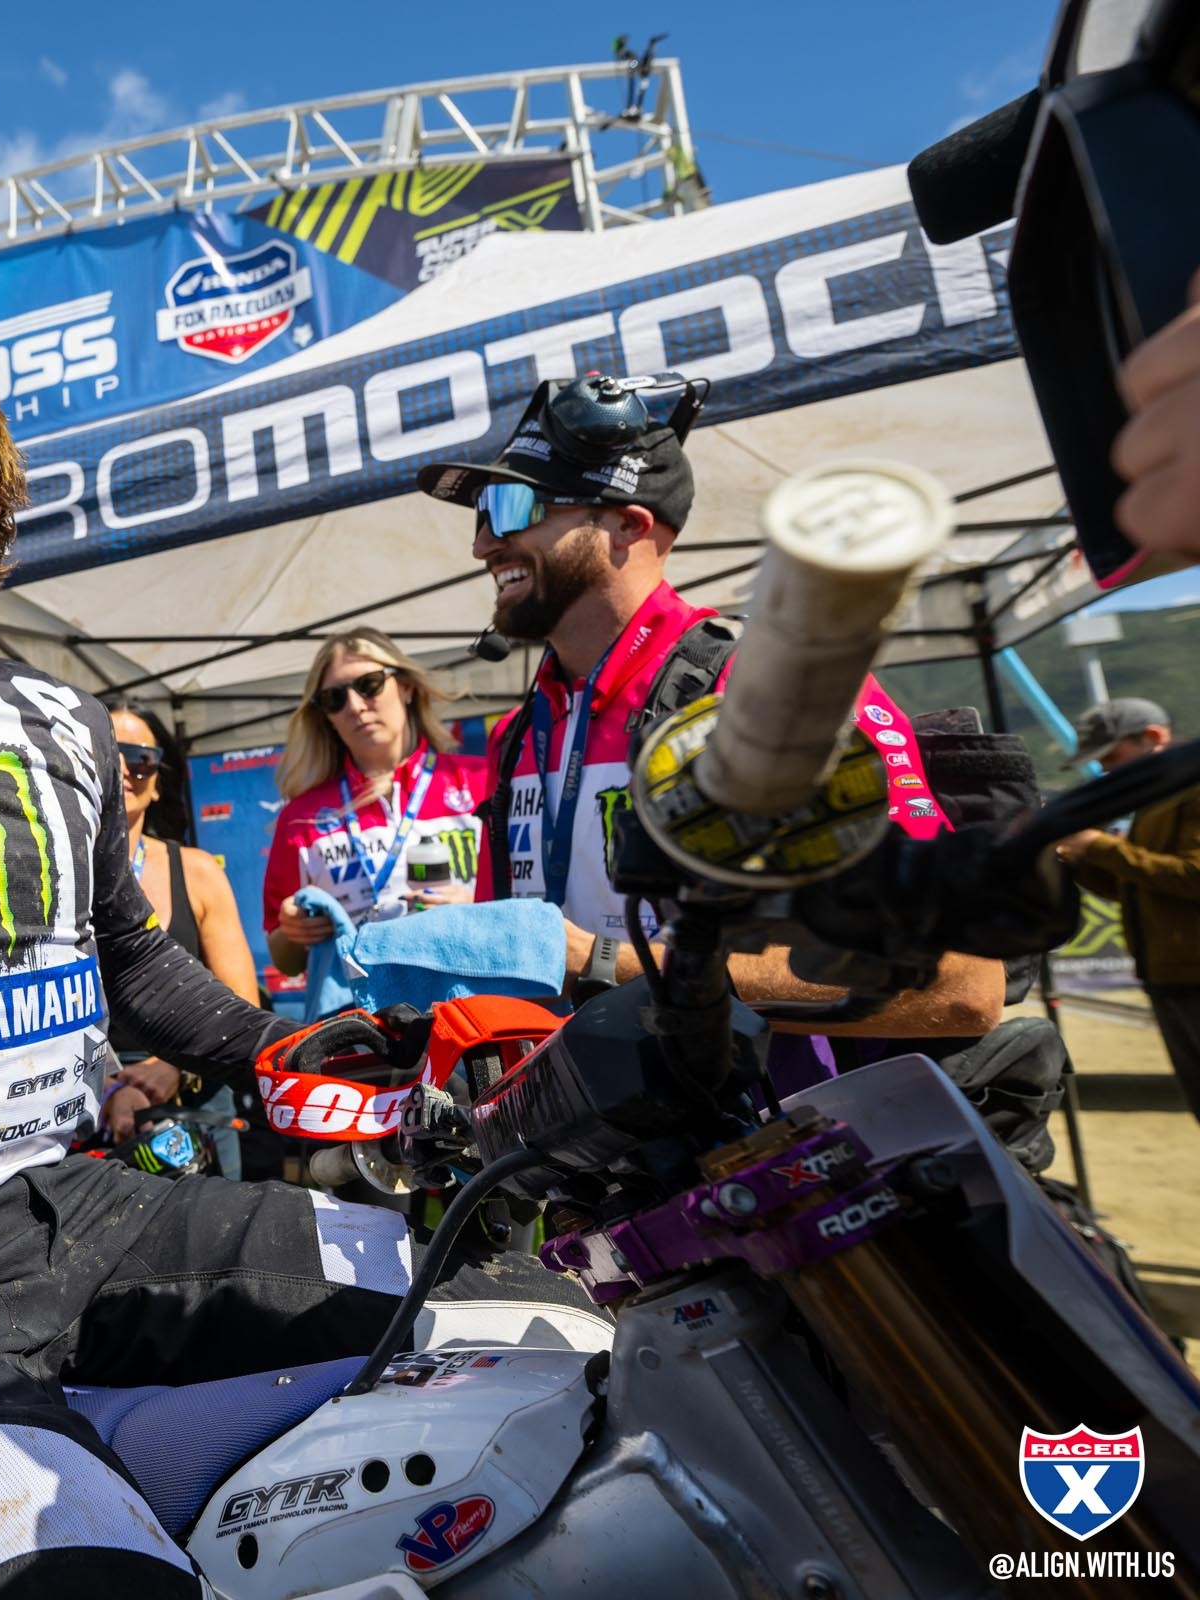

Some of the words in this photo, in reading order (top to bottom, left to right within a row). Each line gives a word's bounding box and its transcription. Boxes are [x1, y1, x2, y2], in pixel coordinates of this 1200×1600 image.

[173, 304, 205, 331] FOX
[211, 282, 296, 320] RACEWAY
[7, 1068, 67, 1099] GYTR
[37, 1119, 51, 1132] USA
[672, 1299, 720, 1325] AMA
[217, 1468, 353, 1529] GYTR
[215, 1525, 242, 1539] GENUINE
[243, 1518, 268, 1531] YAMAHA
[269, 1507, 317, 1523] TECHNOLOGY
[318, 1503, 349, 1513] RACING
[396, 1503, 458, 1563] VP
